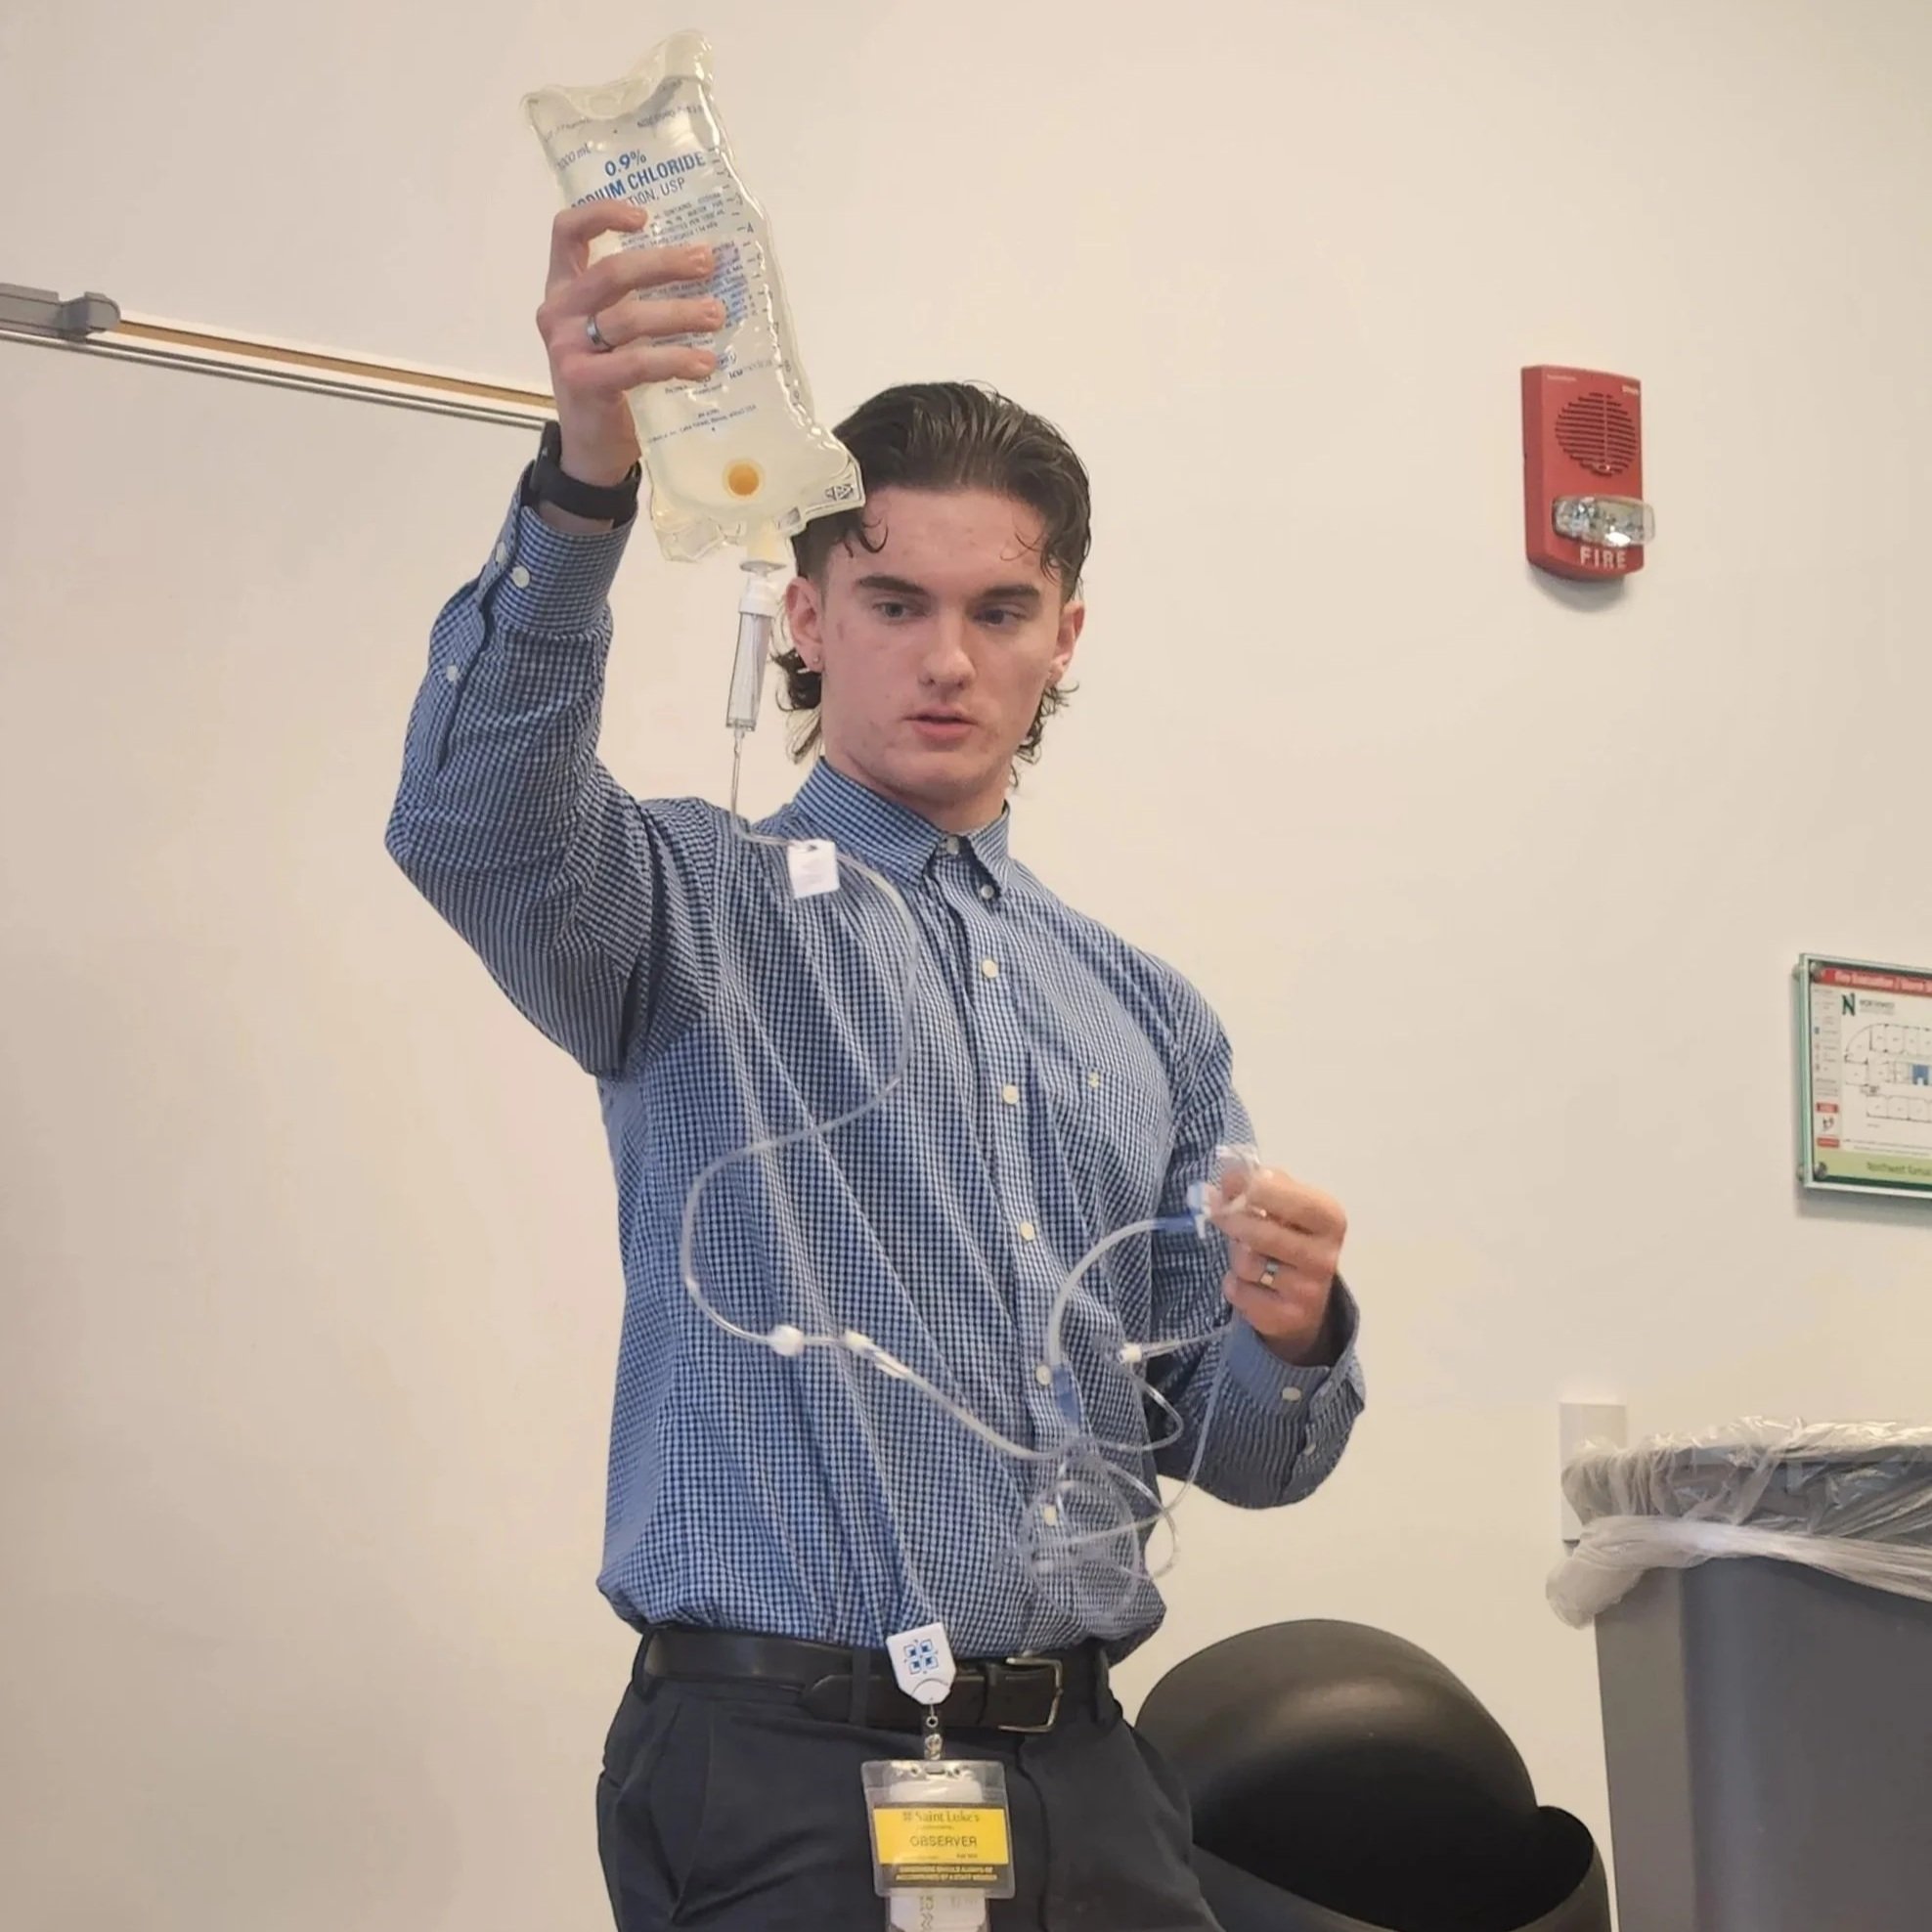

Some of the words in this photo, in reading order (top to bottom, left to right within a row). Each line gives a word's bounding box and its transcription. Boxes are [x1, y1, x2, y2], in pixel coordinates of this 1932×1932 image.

[604, 150, 647, 178] 0.9%
[627, 152, 707, 191] CHLORIDE
[661, 177, 686, 197] USP
[1579, 546, 1628, 569] FIRE
[1841, 993, 1857, 1017] N
[909, 1835, 978, 1847] OBSERVER
